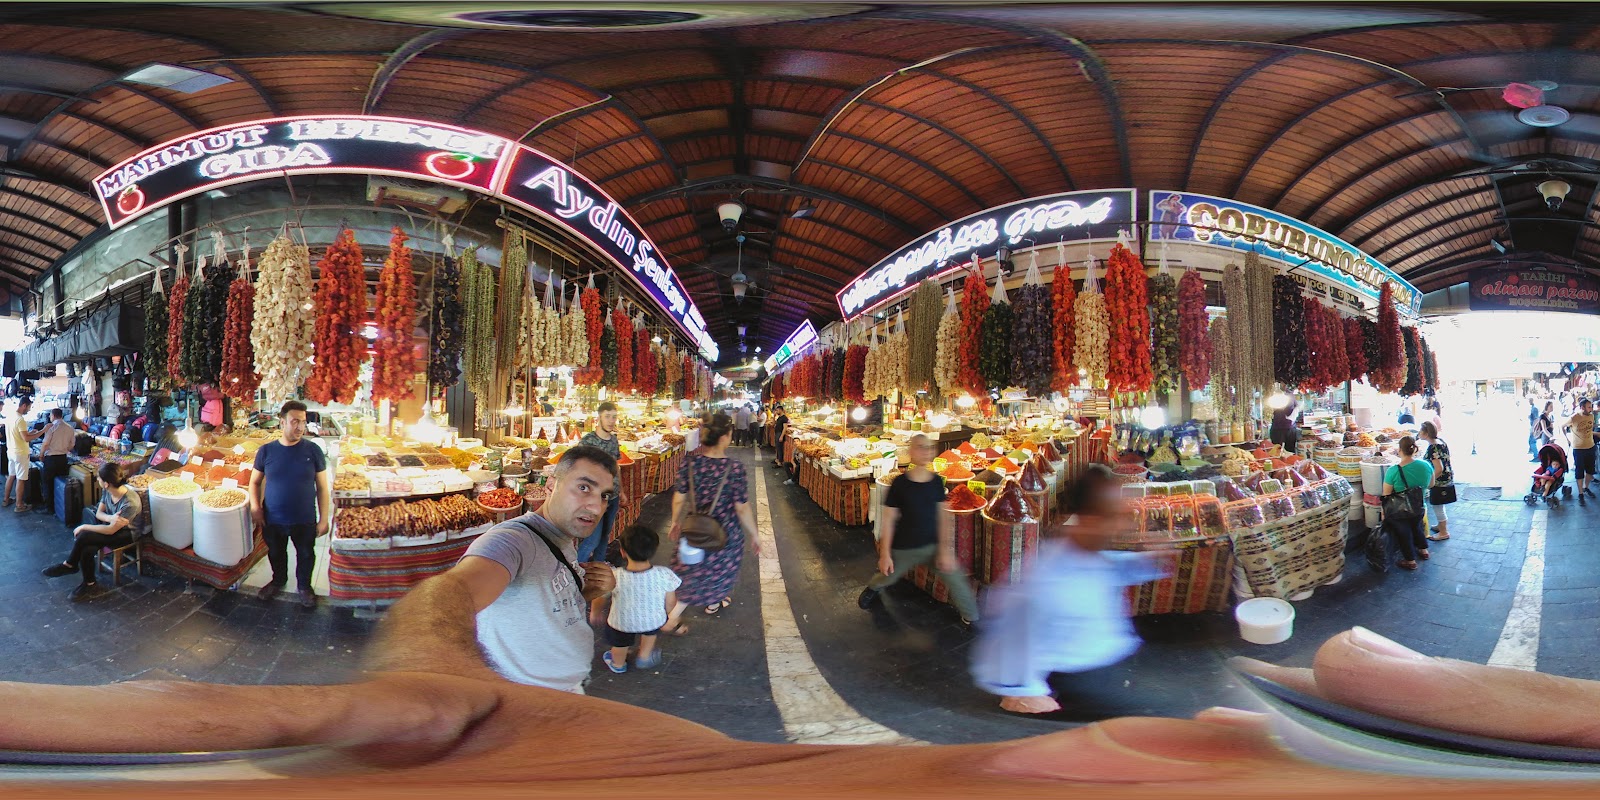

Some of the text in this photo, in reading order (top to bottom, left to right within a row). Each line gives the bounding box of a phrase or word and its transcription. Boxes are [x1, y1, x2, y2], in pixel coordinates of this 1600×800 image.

[99, 124, 268, 198] MAHMUT
[199, 142, 331, 178] GIDA
[524, 165, 636, 256] Aydın
[1187, 202, 1386, 292] ÇOPURUNOĞLU
[1482, 280, 1598, 301] almacı pazarı
[1520, 272, 1566, 284] TARİHİ
